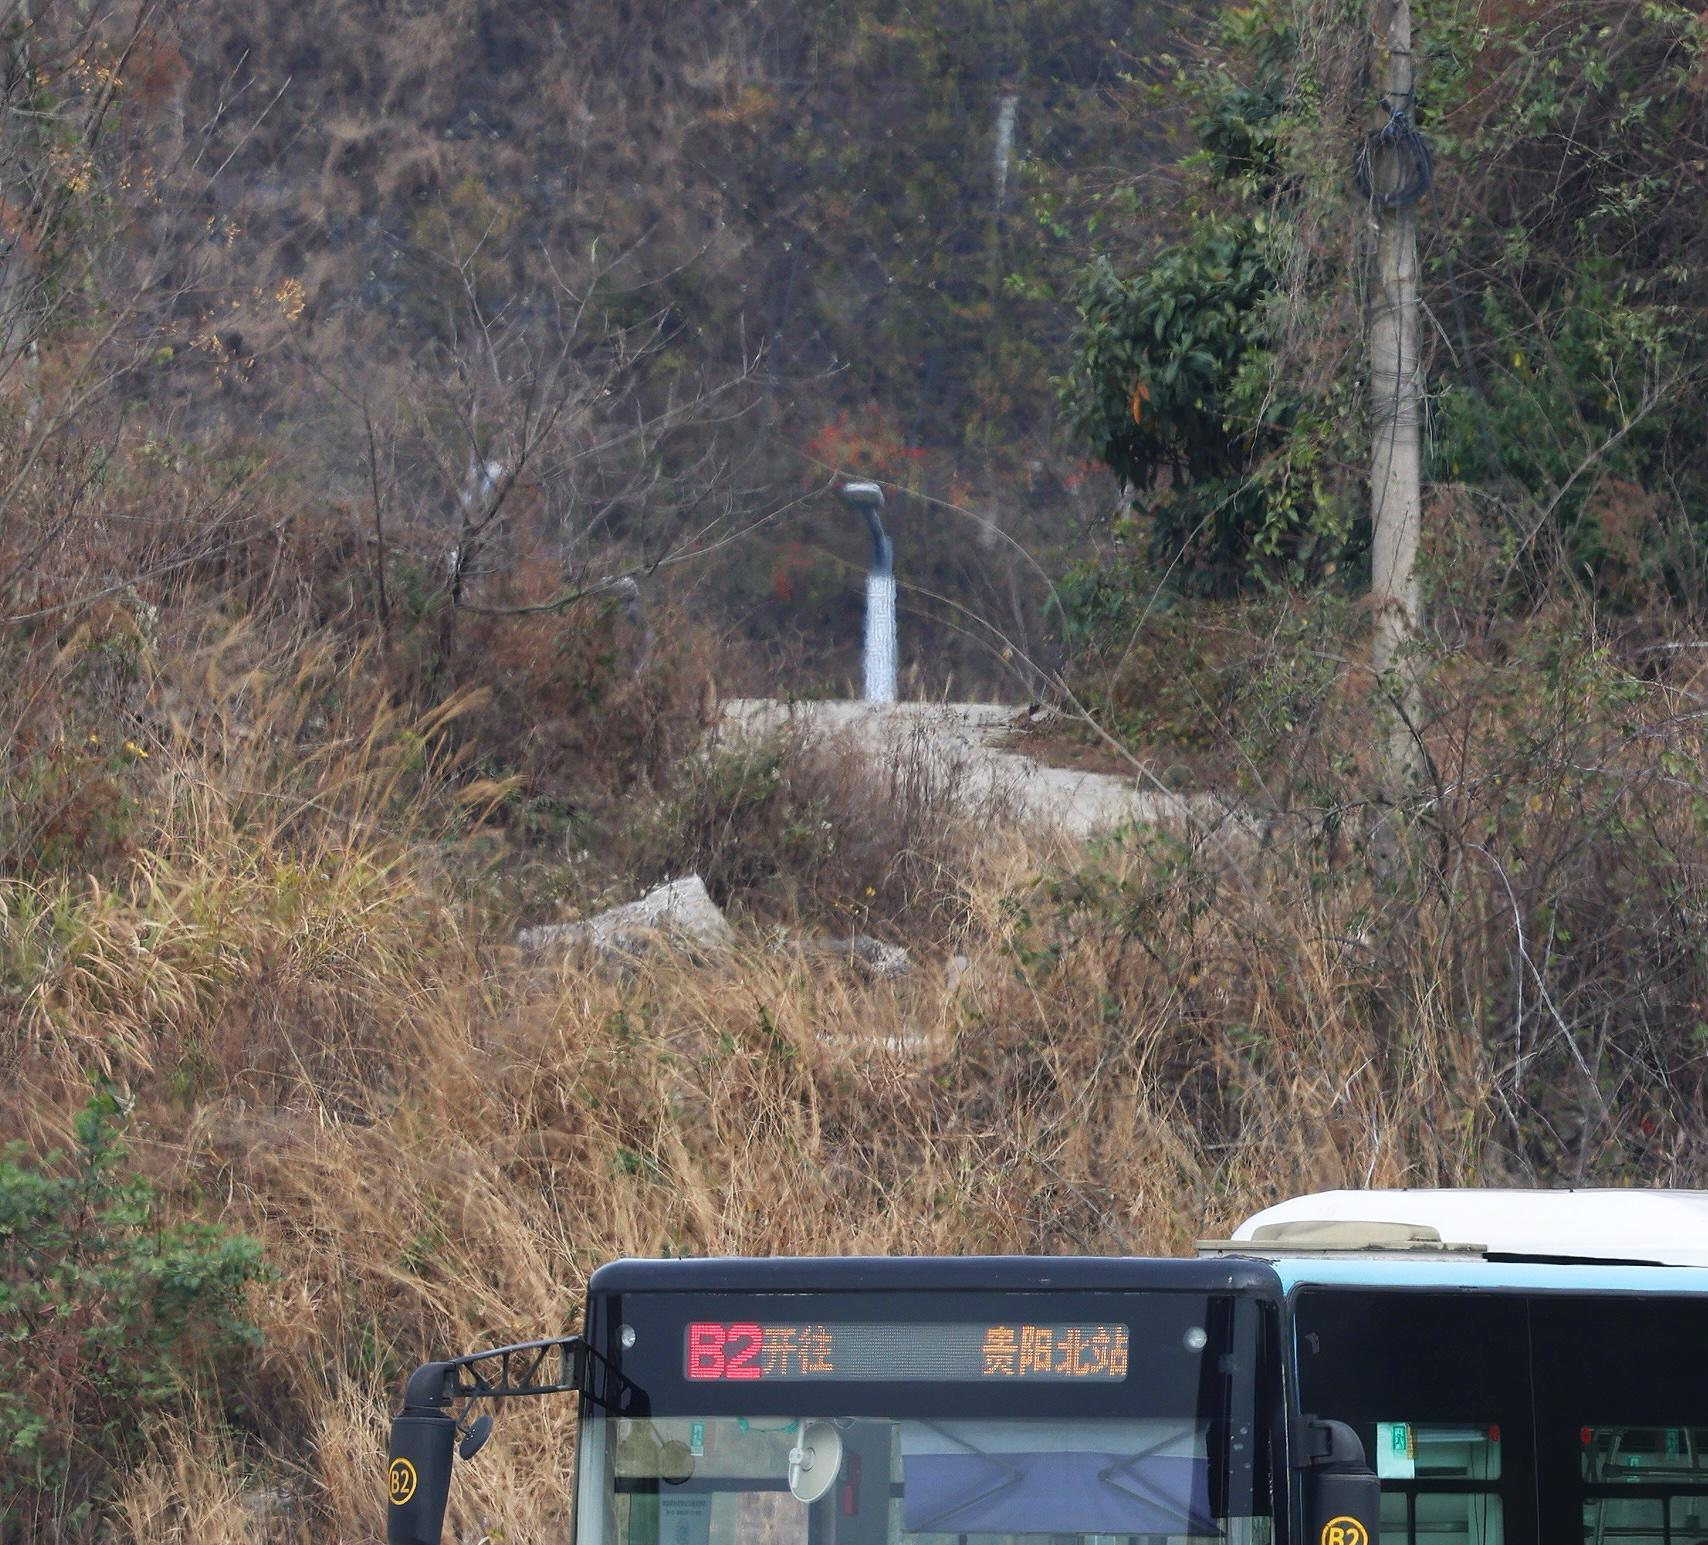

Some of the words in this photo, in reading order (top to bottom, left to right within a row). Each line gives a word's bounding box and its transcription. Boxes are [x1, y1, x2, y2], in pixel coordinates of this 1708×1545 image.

[689, 1323, 763, 1378] B2
[763, 1325, 833, 1375] 开往
[981, 1325, 1129, 1376] 贵阳北站
[391, 1469, 410, 1494] B2
